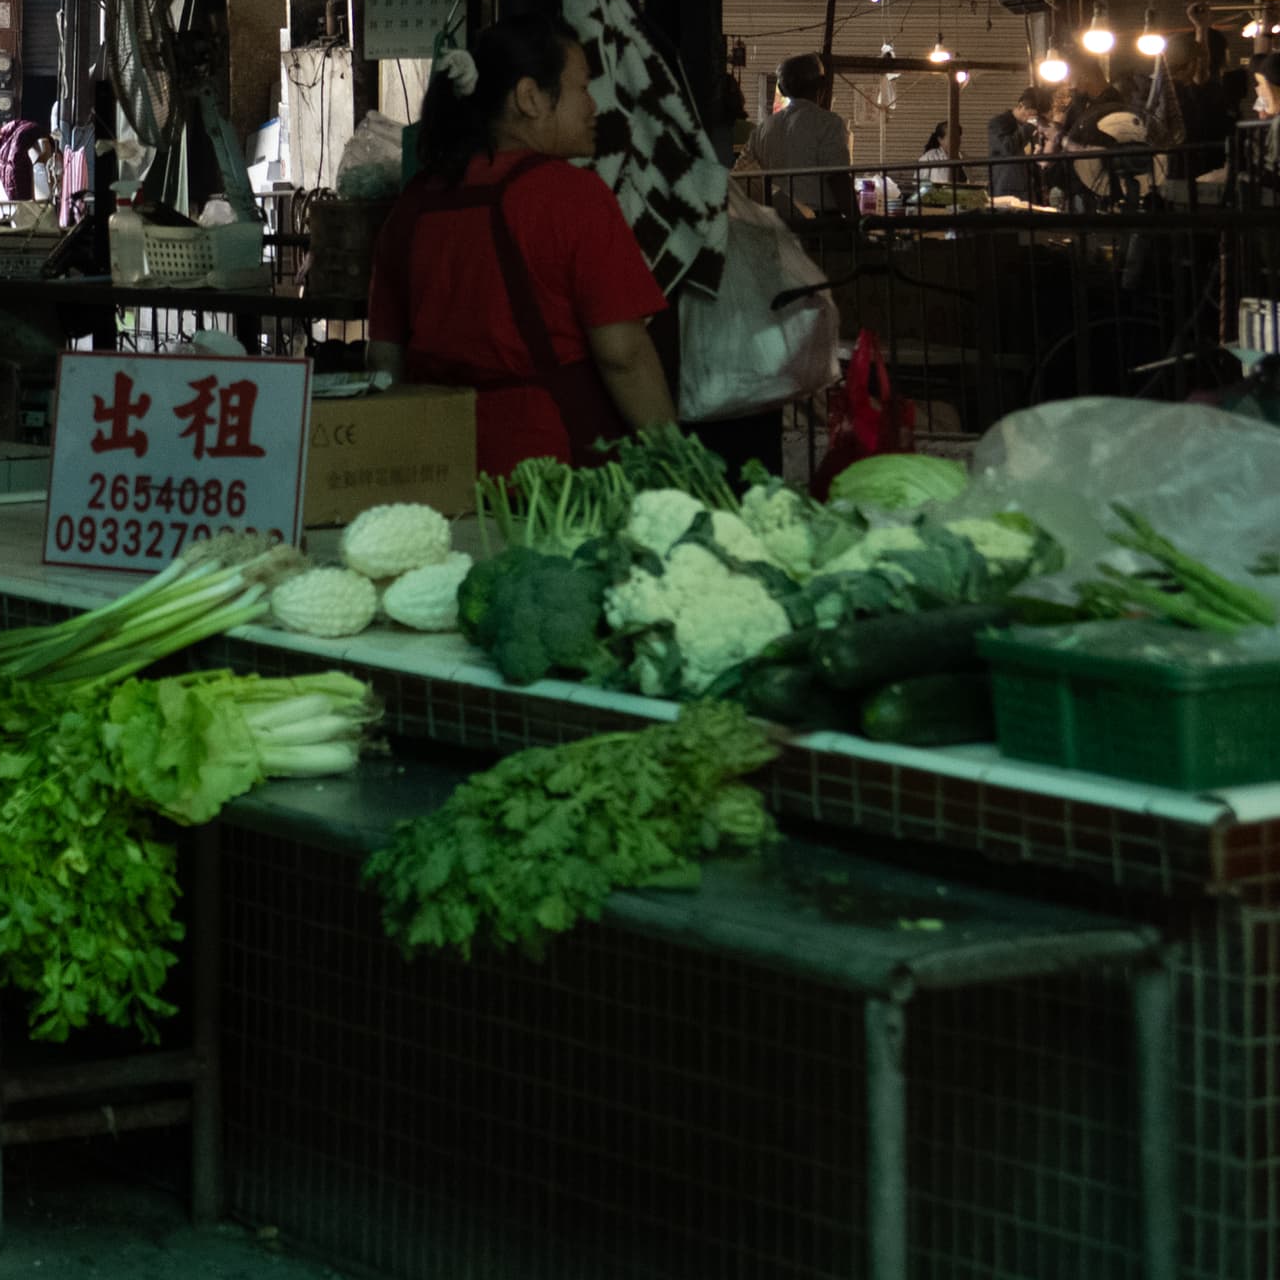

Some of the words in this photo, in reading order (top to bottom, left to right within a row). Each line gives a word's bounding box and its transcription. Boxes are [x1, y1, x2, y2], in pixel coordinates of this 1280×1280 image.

[90, 371, 265, 460] 出租
[88, 473, 246, 516] 2654086
[56, 515, 283, 559] 093327
